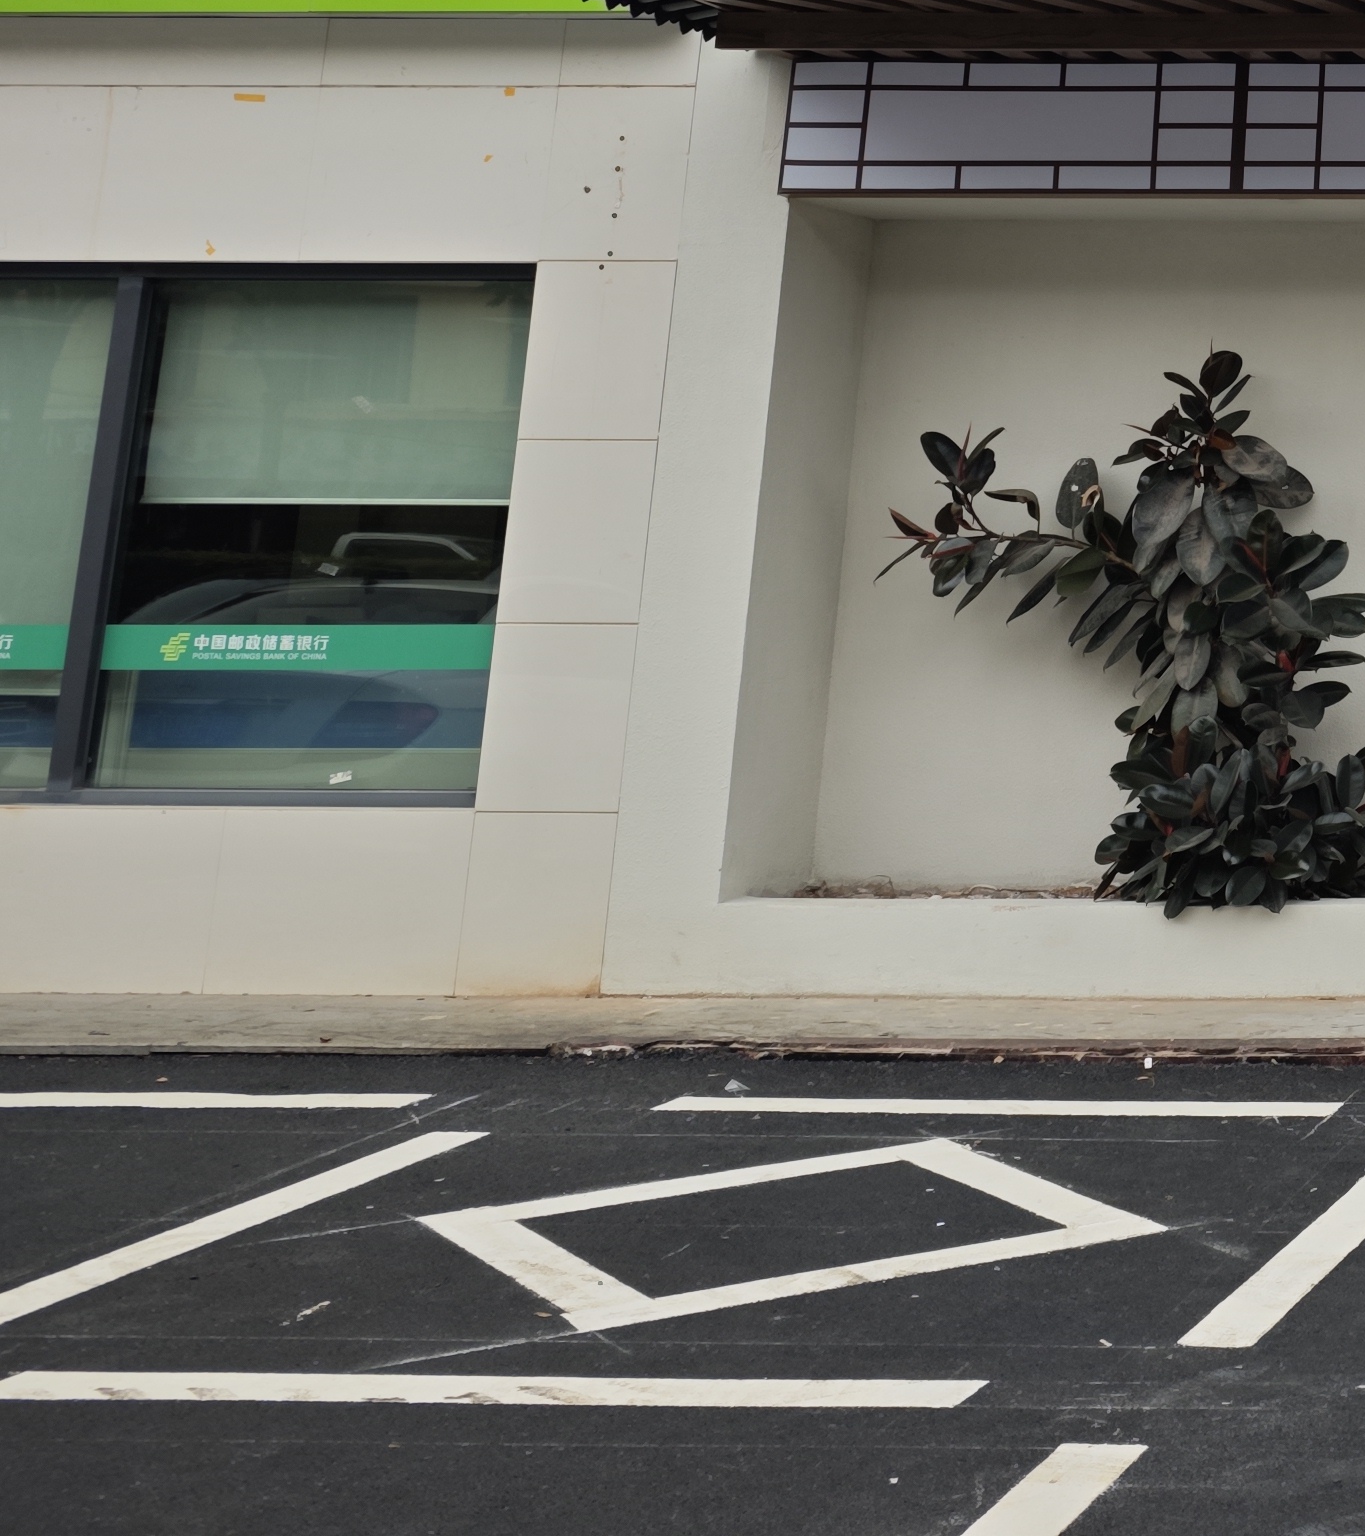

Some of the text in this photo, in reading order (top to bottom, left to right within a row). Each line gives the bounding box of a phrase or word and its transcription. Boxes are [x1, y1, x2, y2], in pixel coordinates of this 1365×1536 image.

[194, 634, 330, 651] 中国邮政储蓄银行
